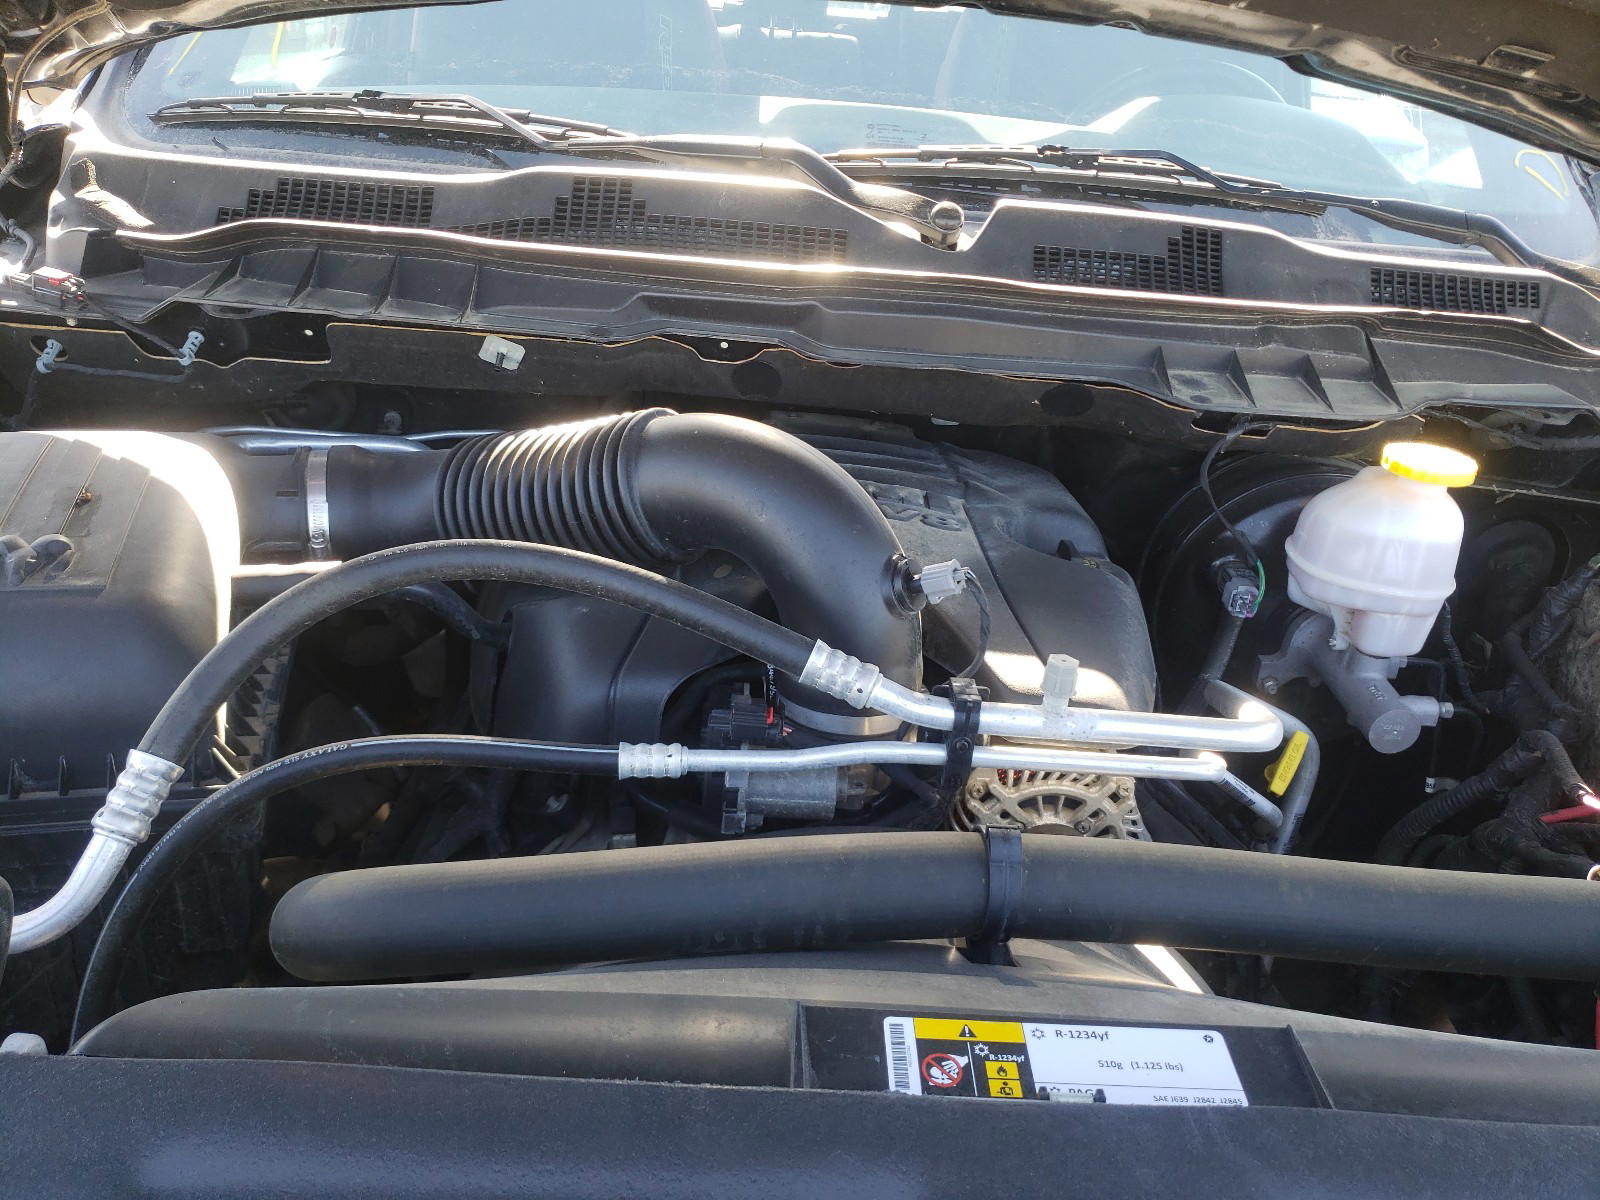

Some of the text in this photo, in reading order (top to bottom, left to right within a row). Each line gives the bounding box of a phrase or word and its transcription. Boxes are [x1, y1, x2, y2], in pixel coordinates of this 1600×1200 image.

[301, 743, 348, 760] GALAXY
[284, 755, 300, 765] SLE
[1055, 1029, 1110, 1041] R-1234yf
[989, 1053, 1025, 1063] R-1234yf
[1097, 1059, 1184, 1073] 510g (1.125 lbs)
